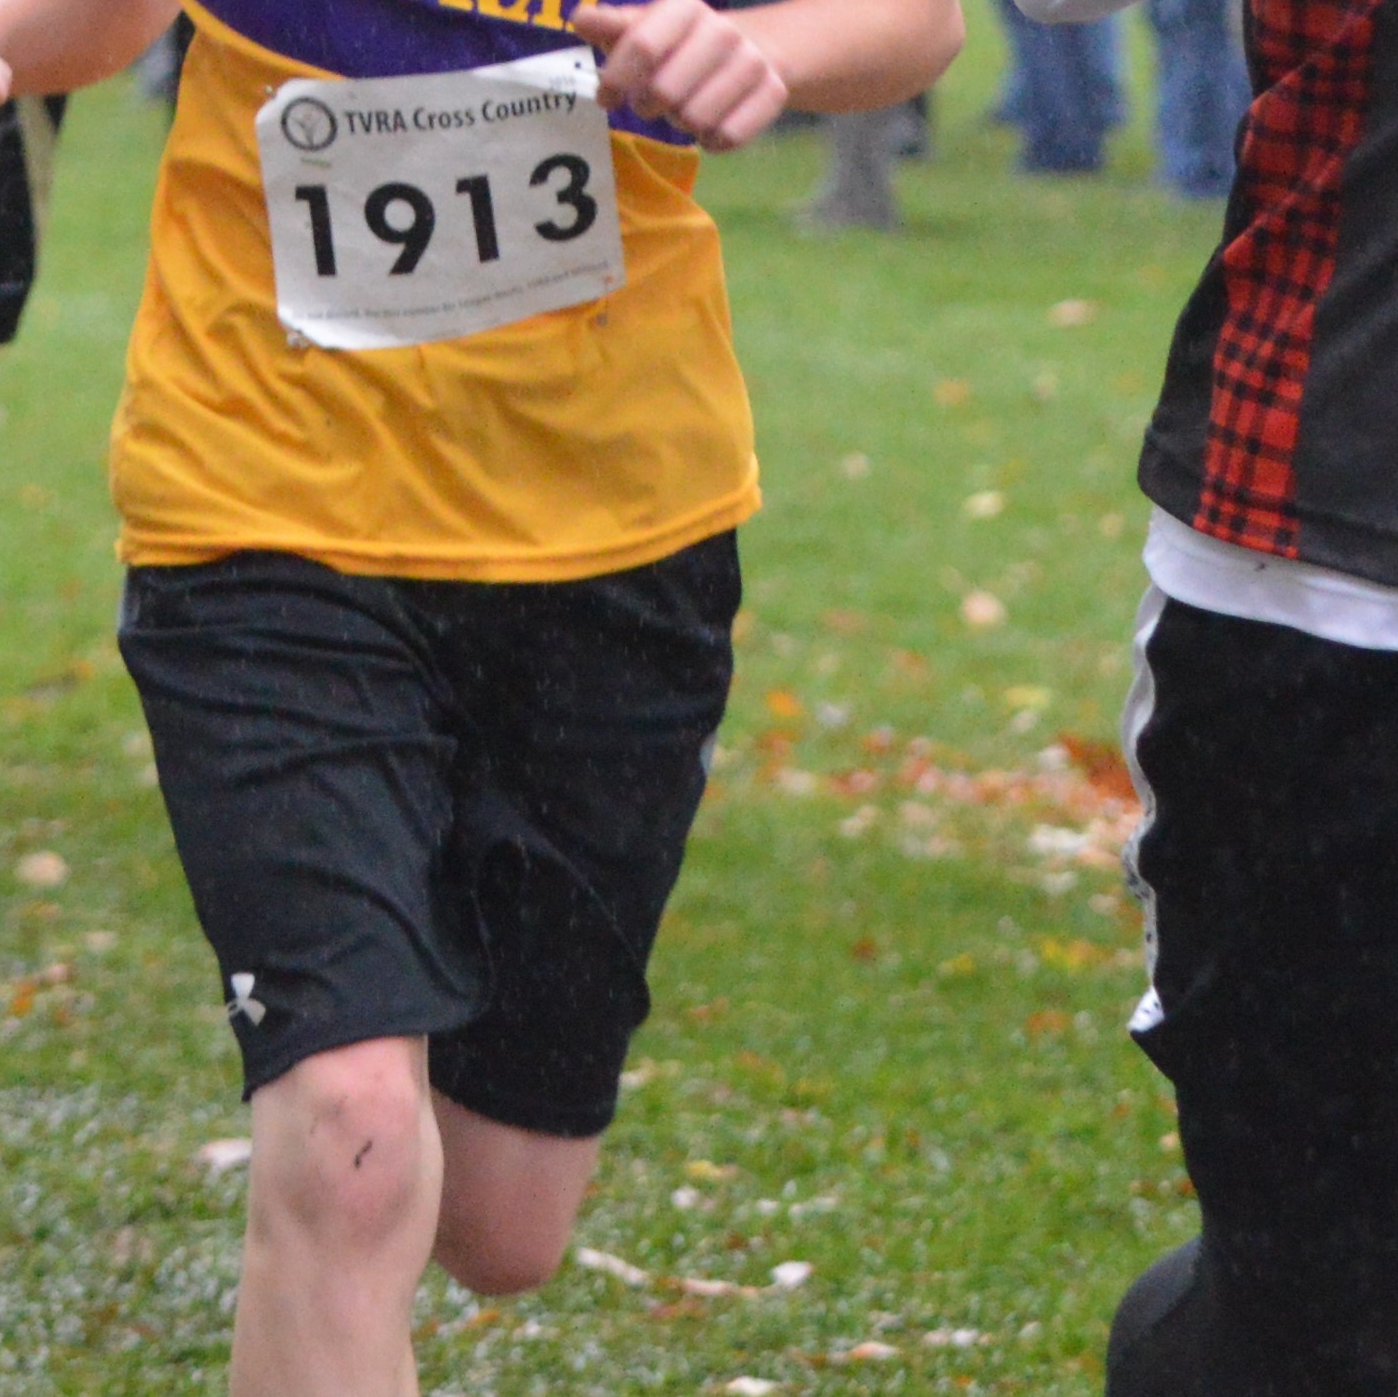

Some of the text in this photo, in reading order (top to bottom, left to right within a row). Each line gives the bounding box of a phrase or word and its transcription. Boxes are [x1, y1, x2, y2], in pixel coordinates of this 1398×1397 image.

[344, 110, 407, 134] TVRA
[413, 106, 475, 132] Cross
[481, 92, 577, 122] Country
[294, 153, 597, 277] 1913
